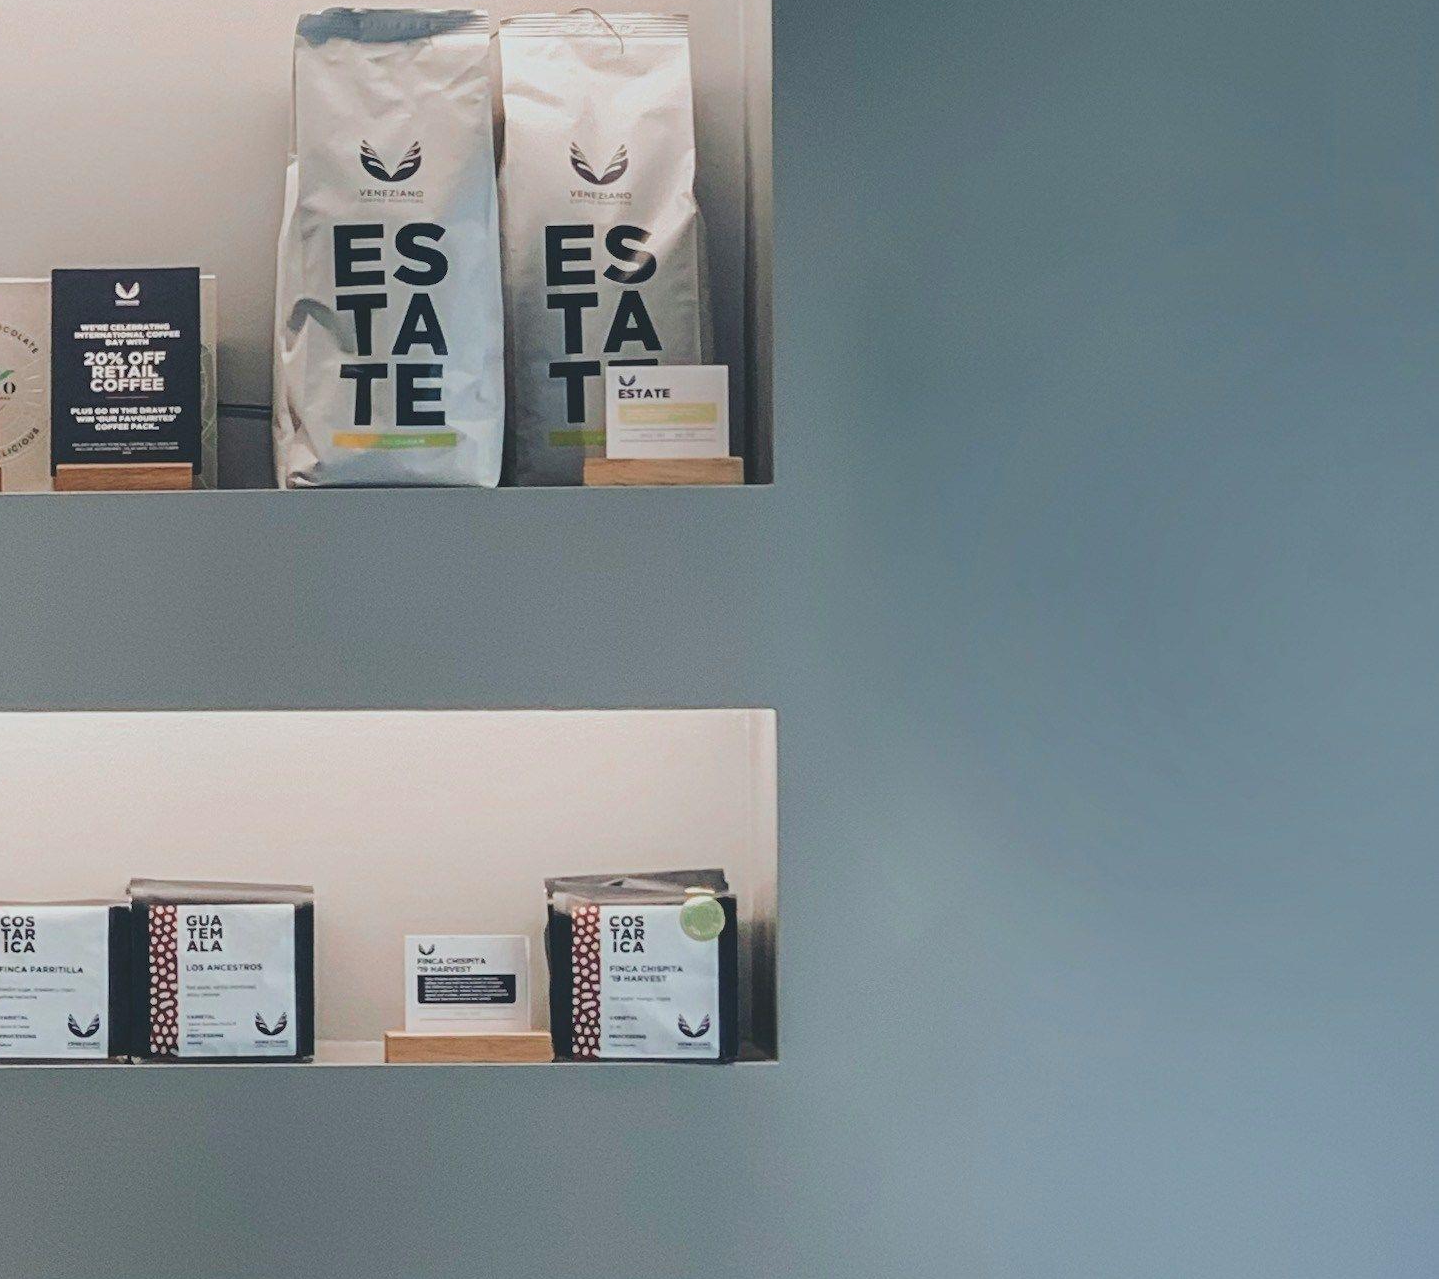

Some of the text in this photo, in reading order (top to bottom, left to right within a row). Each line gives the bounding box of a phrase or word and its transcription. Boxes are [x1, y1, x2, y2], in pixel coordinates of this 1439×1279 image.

[360, 189, 424, 197] VENEZIANO
[570, 190, 632, 199] VENEZIANO
[333, 222, 449, 287] ES
[544, 223, 658, 287] ES
[336, 293, 449, 357] TA
[547, 291, 663, 354] TA
[84, 351, 166, 366] 20% OFF
[92, 365, 158, 379] RETAIL
[90, 378, 164, 392] COFFEE
[548, 359, 658, 423] T
[340, 362, 446, 427] TE
[618, 389, 670, 399] ESTATE
[1, 916, 35, 928] COS
[187, 915, 222, 927] GUA
[609, 915, 644, 928] COS
[1, 929, 35, 940] TAR
[187, 928, 223, 939] TEM
[611, 928, 645, 941] TAR
[4, 941, 35, 953] ICA
[187, 940, 223, 952] ALA
[613, 941, 645, 953] ICA
[186, 963, 262, 972] LOS ANCESTROS
[610, 965, 638, 973] FINCA
